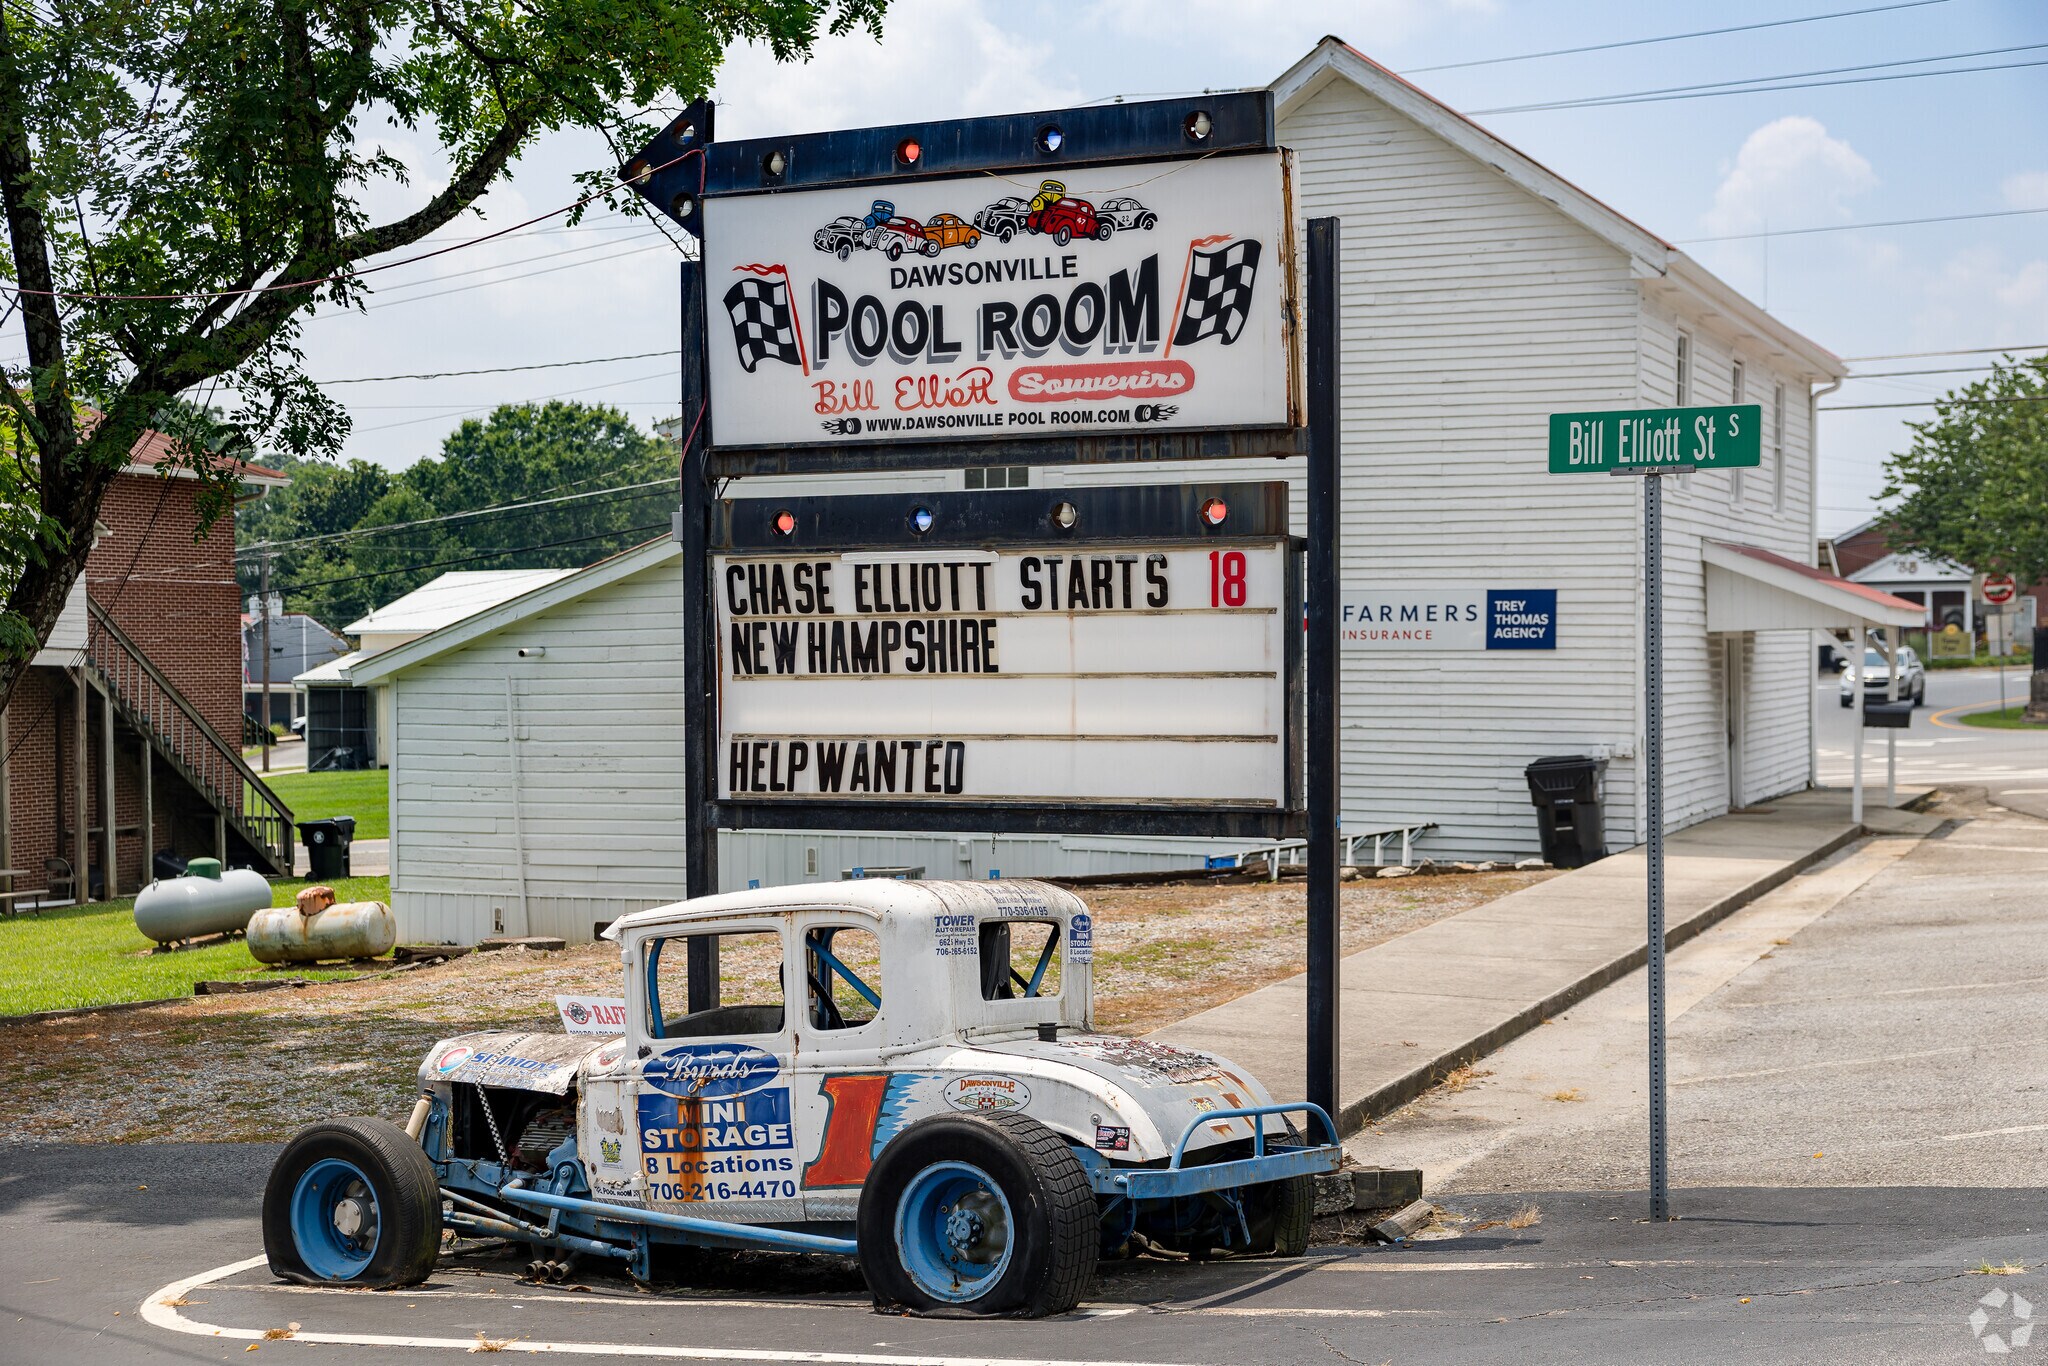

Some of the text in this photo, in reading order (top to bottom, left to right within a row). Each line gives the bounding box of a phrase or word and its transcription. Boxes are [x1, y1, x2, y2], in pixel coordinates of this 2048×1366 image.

[1020, 217, 1026, 226] 9
[1076, 217, 1086, 225] 47
[890, 255, 1078, 289] DAWSONVILLE
[812, 253, 1160, 370] POOL ROOM
[812, 366, 1185, 415] Bill Elliott Souvenirs
[866, 408, 1131, 433] WWW.DAWSONVILLE POOL ROOM.COM
[1569, 413, 1740, 465] Bill Elliott St S
[725, 551, 1247, 616] CHASE ELLIOTT STARTS 18
[1343, 604, 1478, 622] FARMERS
[1494, 600, 1526, 612] TREY
[1494, 613, 1549, 626] THOMAS
[1342, 630, 1433, 641] INSURANCE
[1494, 627, 1546, 639] AGENCY
[731, 618, 1000, 675] NEW HAMPSHIRE
[729, 740, 966, 795] HELP WANTED
[934, 915, 975, 927] TOWER
[998, 906, 1049, 917] 770-536-1195
[954, 938, 966, 947] Hwy
[960, 1079, 1016, 1093] DAWSONVILLE
[677, 1101, 746, 1124] MINI
[644, 1124, 789, 1149] STORAGE
[802, 1072, 893, 1190] 1
[646, 1155, 794, 1174] 8 Locations
[650, 1180, 796, 1200] 706-216-4470
